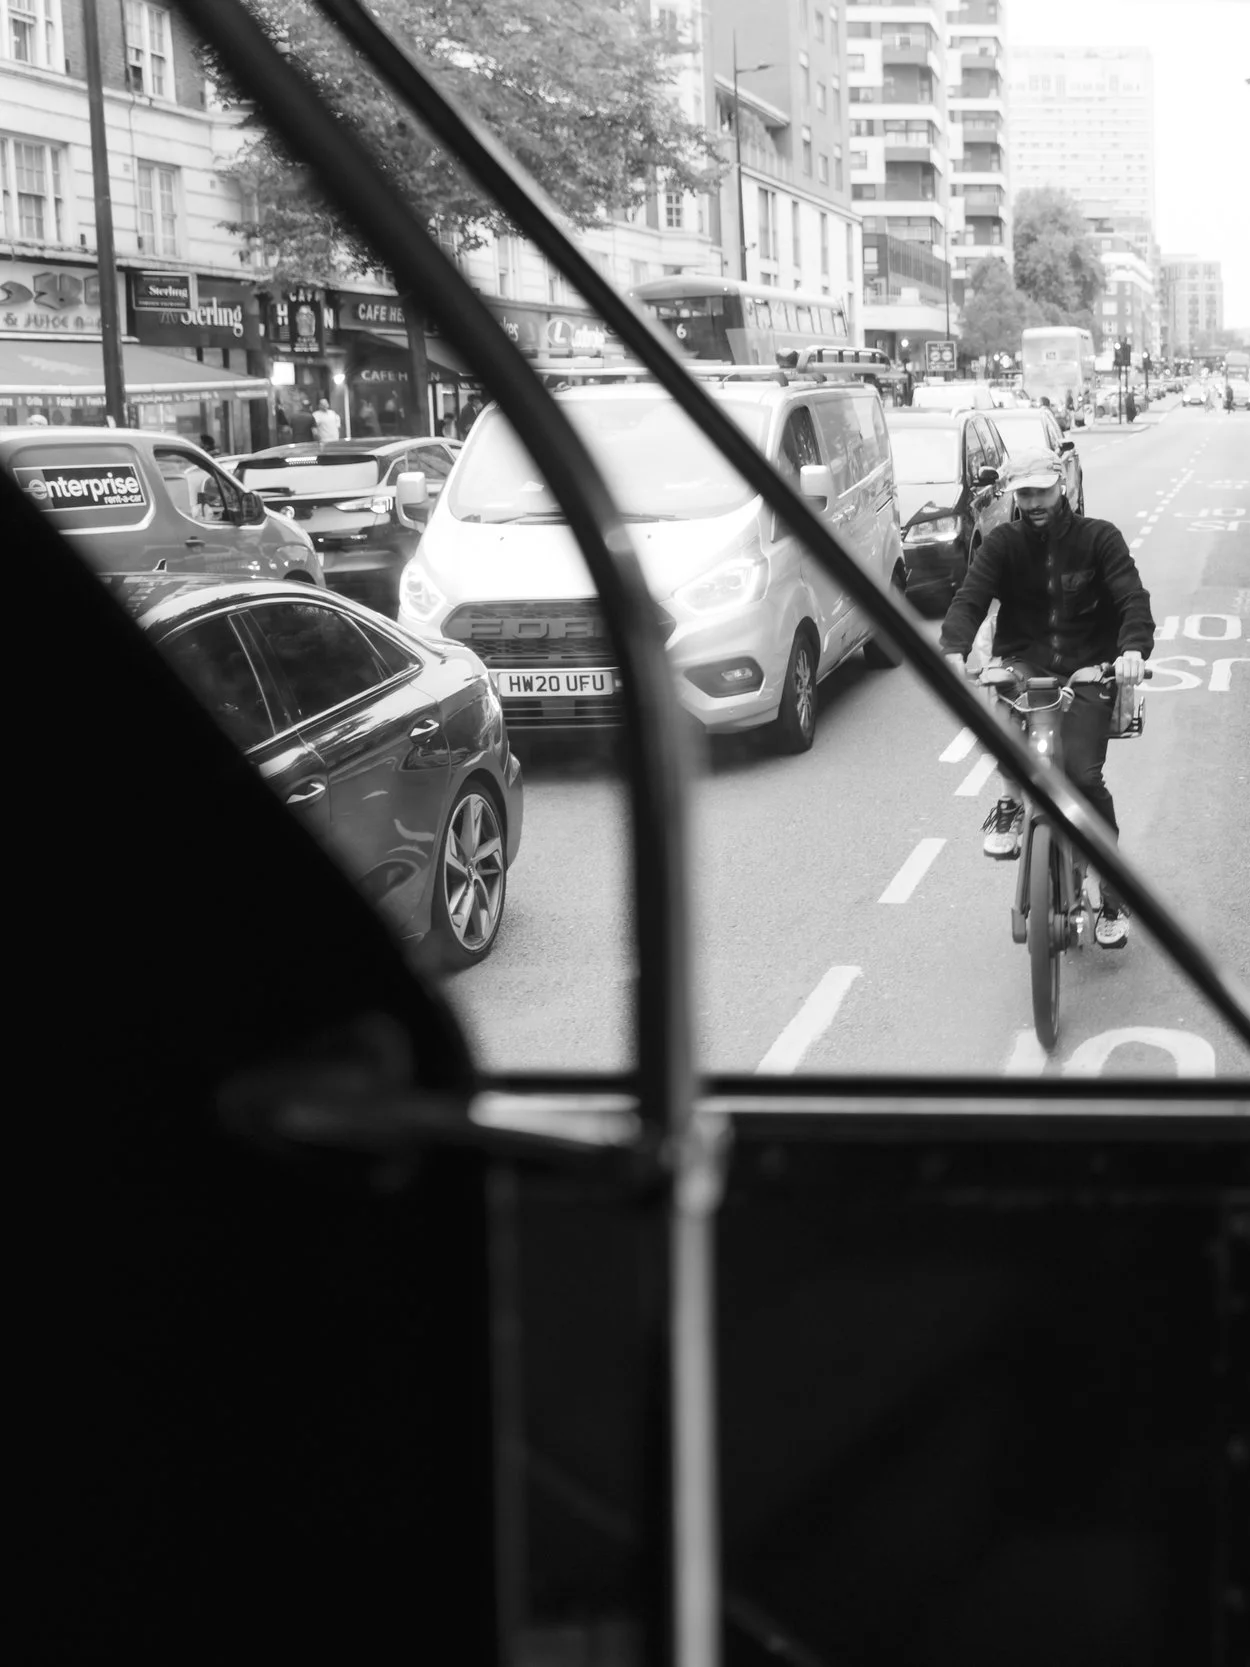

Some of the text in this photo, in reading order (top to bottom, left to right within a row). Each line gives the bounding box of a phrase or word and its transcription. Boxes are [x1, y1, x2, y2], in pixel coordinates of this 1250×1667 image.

[358, 303, 388, 321] CAFE
[676, 323, 687, 339] 6
[23, 472, 140, 503] enterprise
[104, 494, 142, 504] rent-a-car
[509, 674, 605, 693] HW20 UFU
